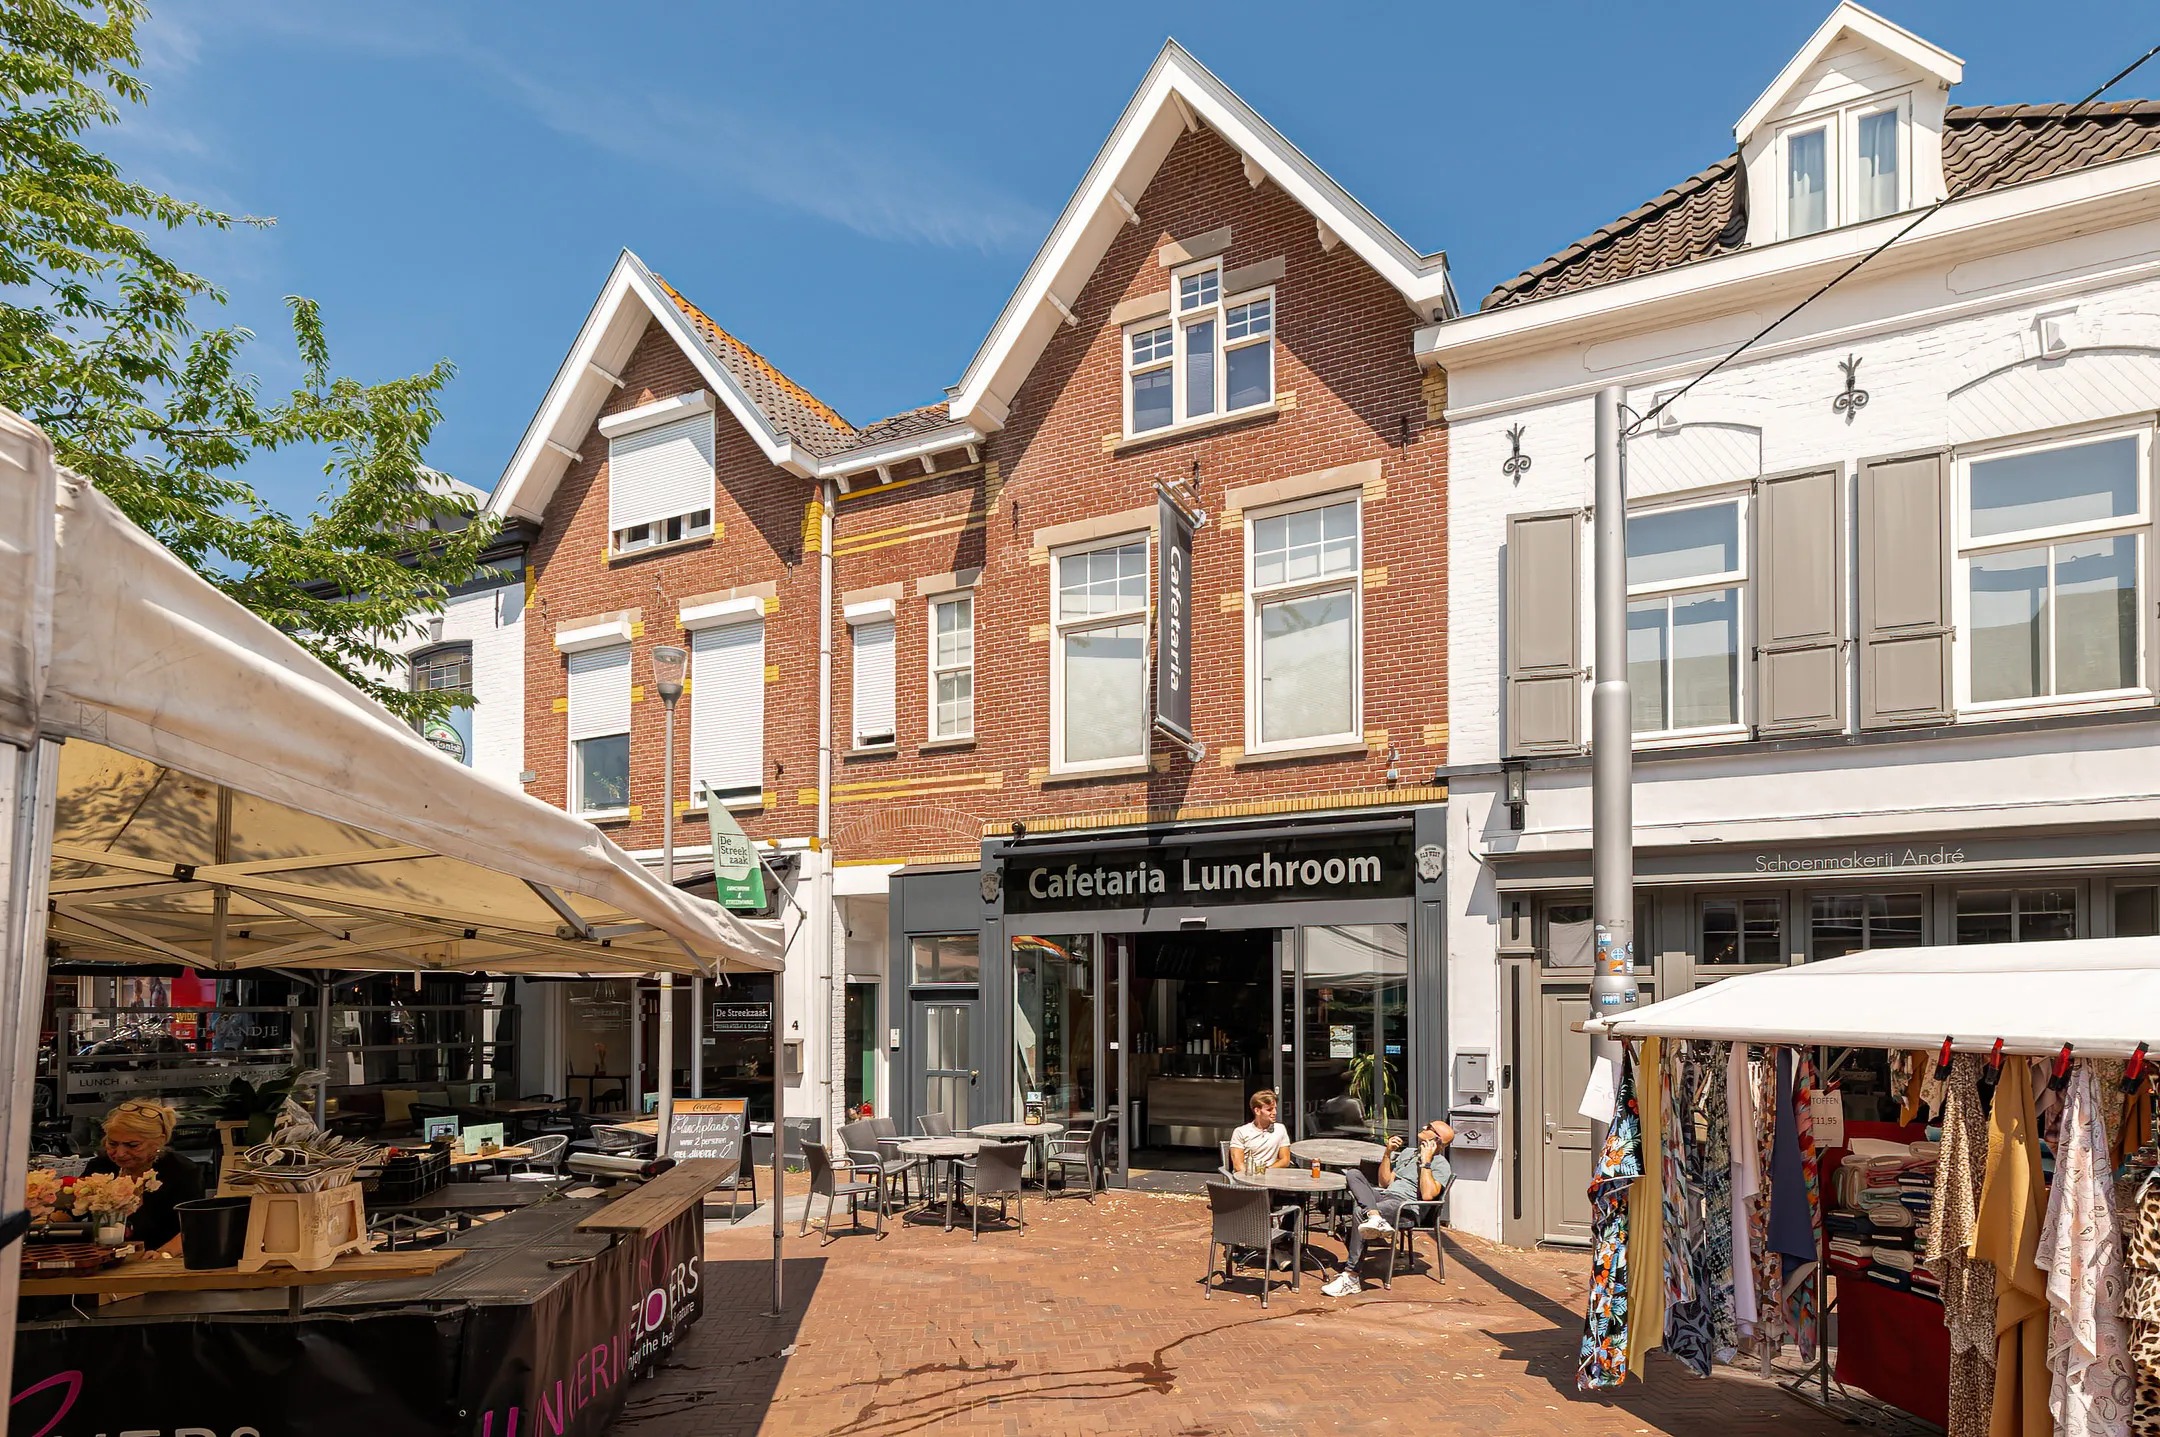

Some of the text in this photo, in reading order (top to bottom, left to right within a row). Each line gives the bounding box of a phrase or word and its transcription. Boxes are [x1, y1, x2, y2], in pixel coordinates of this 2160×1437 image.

[1169, 545, 1182, 692] Cafetaria
[720, 836, 732, 845] De
[721, 846, 748, 856] Streek
[730, 856, 749, 865] zaak
[1755, 846, 1965, 872] Schoenmakerij André
[1028, 852, 1382, 899] Cafetaria Lunchroom
[716, 1008, 768, 1017] De Streekzaak
[791, 1020, 799, 1030] 4
[79, 1078, 120, 1087] LUNCH
[1811, 1097, 1839, 1105] TOFFEN
[694, 1136, 700, 1146] 2
[642, 1338, 659, 1357] the
